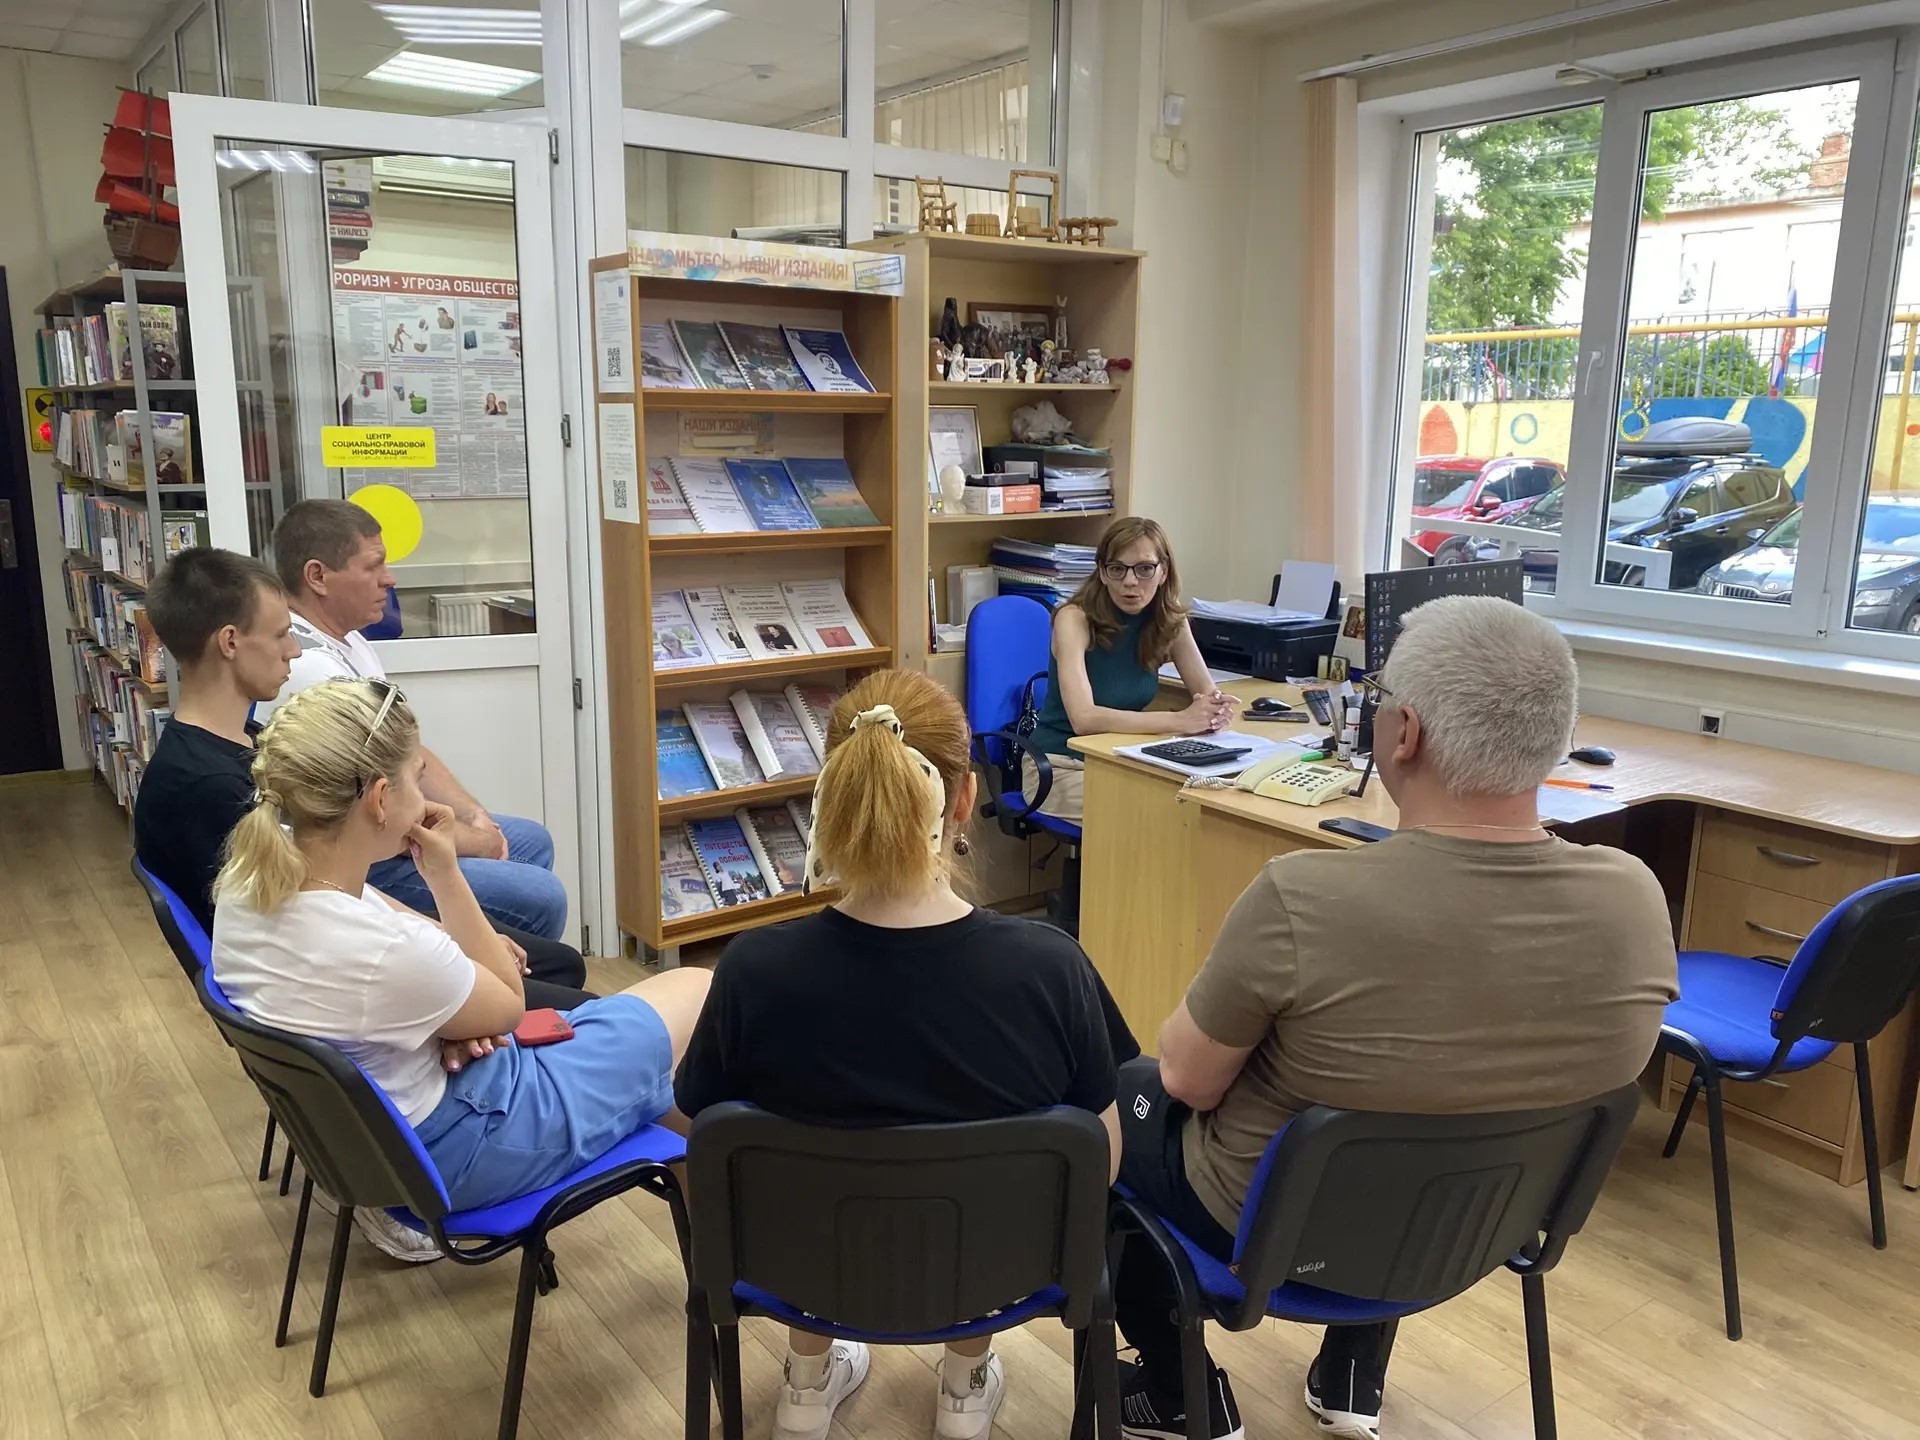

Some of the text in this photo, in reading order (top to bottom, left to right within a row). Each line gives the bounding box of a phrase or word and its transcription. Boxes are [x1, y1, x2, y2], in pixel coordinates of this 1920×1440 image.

[739, 256, 781, 275] НАШИ
[401, 276, 451, 292] УГРОЗА
[684, 418, 715, 431] НАШИ
[332, 440, 426, 448] СОЦИАЛЬНО-ПРАВОВОЙ
